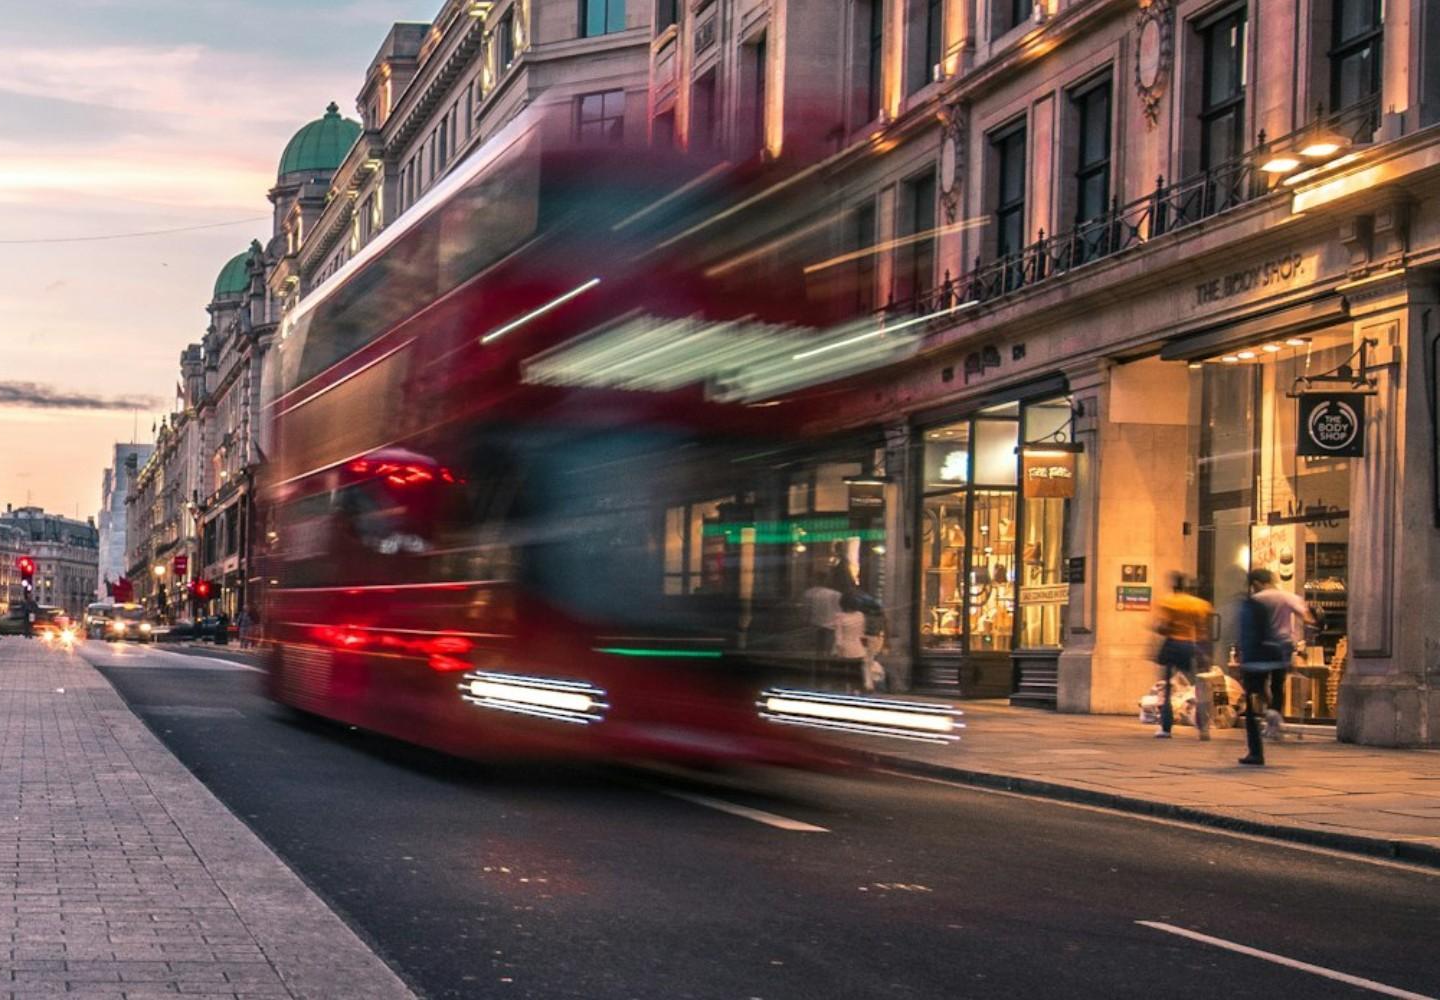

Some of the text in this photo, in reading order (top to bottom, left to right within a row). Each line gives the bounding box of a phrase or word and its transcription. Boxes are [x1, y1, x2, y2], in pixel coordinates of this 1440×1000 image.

[1196, 279, 1220, 304] THE
[1224, 266, 1262, 297] BODY
[1325, 415, 1341, 423] THE
[1318, 423, 1348, 431] BODY
[1320, 432, 1347, 440] SHOP
